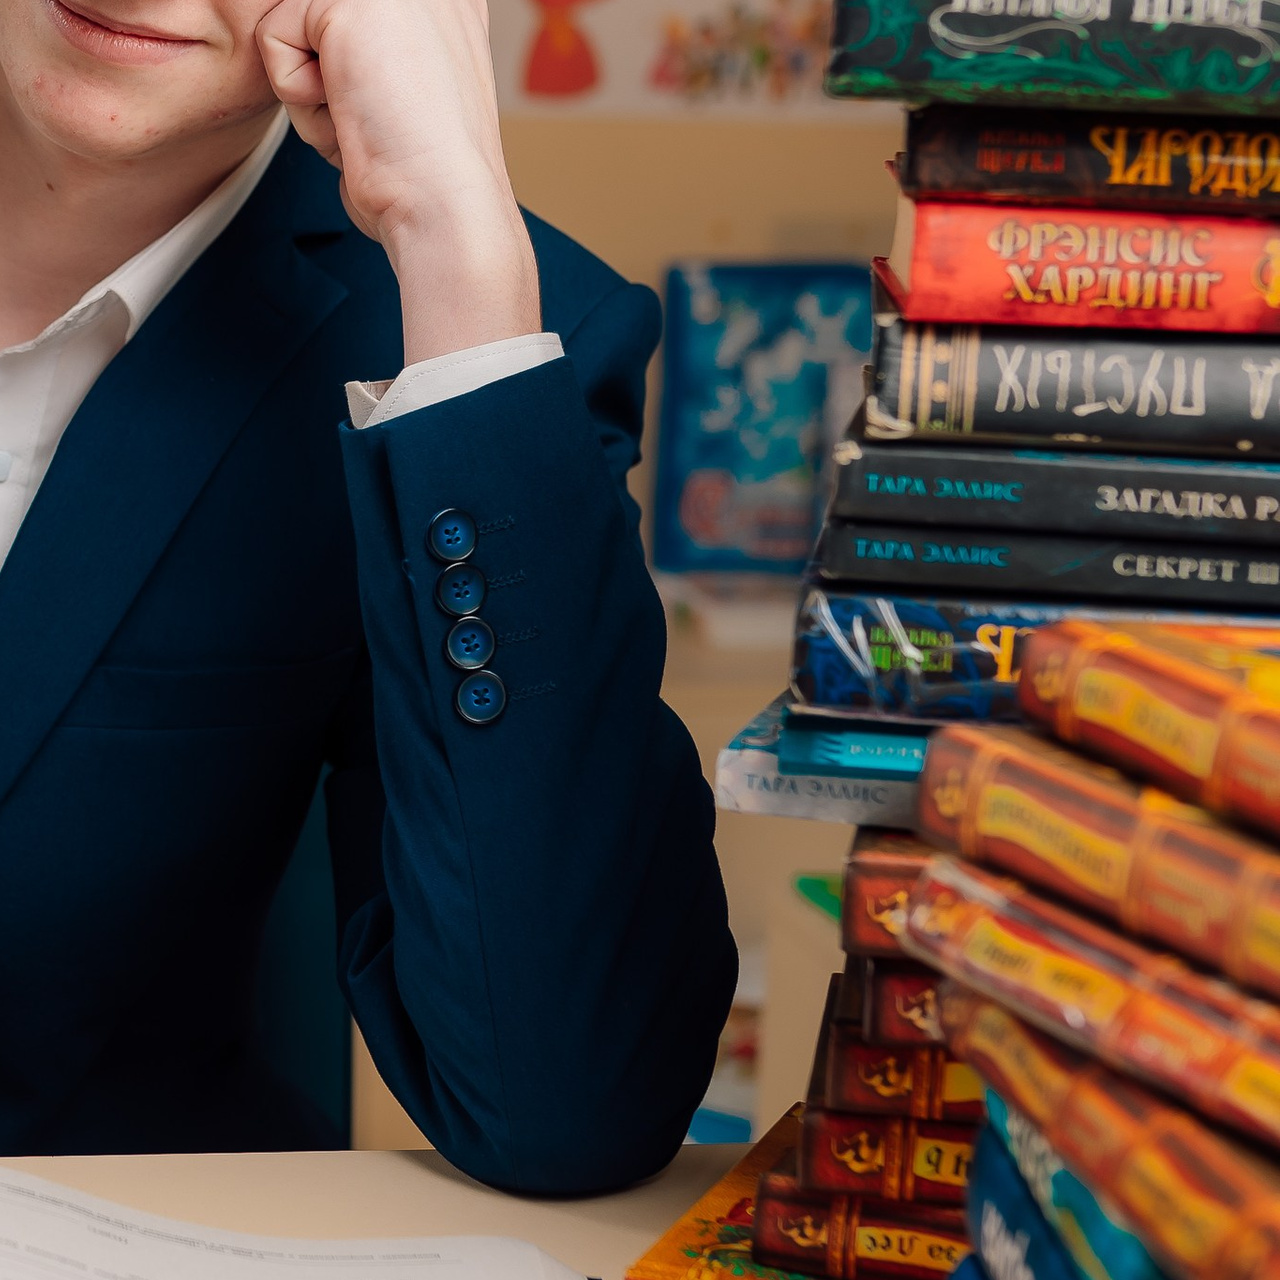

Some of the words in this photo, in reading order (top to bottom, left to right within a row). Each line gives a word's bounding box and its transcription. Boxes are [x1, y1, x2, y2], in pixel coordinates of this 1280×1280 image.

[1090, 126, 1280, 198] ЧАРОДО
[986, 219, 1214, 267] ФРЭНСИС
[1002, 263, 1224, 311] ХАРДИНГ
[992, 343, 1207, 418] ПУСТЫХ
[864, 472, 928, 496] ТАРА
[933, 477, 1025, 503] ЭЛЛИС
[1095, 485, 1248, 520] ЗАГАДКА
[853, 537, 916, 562] ТАРА
[921, 541, 1011, 568] ЭЛЛИС
[1112, 553, 1241, 583] СЕКРЕТ
[746, 774, 799, 796] ТАРА
